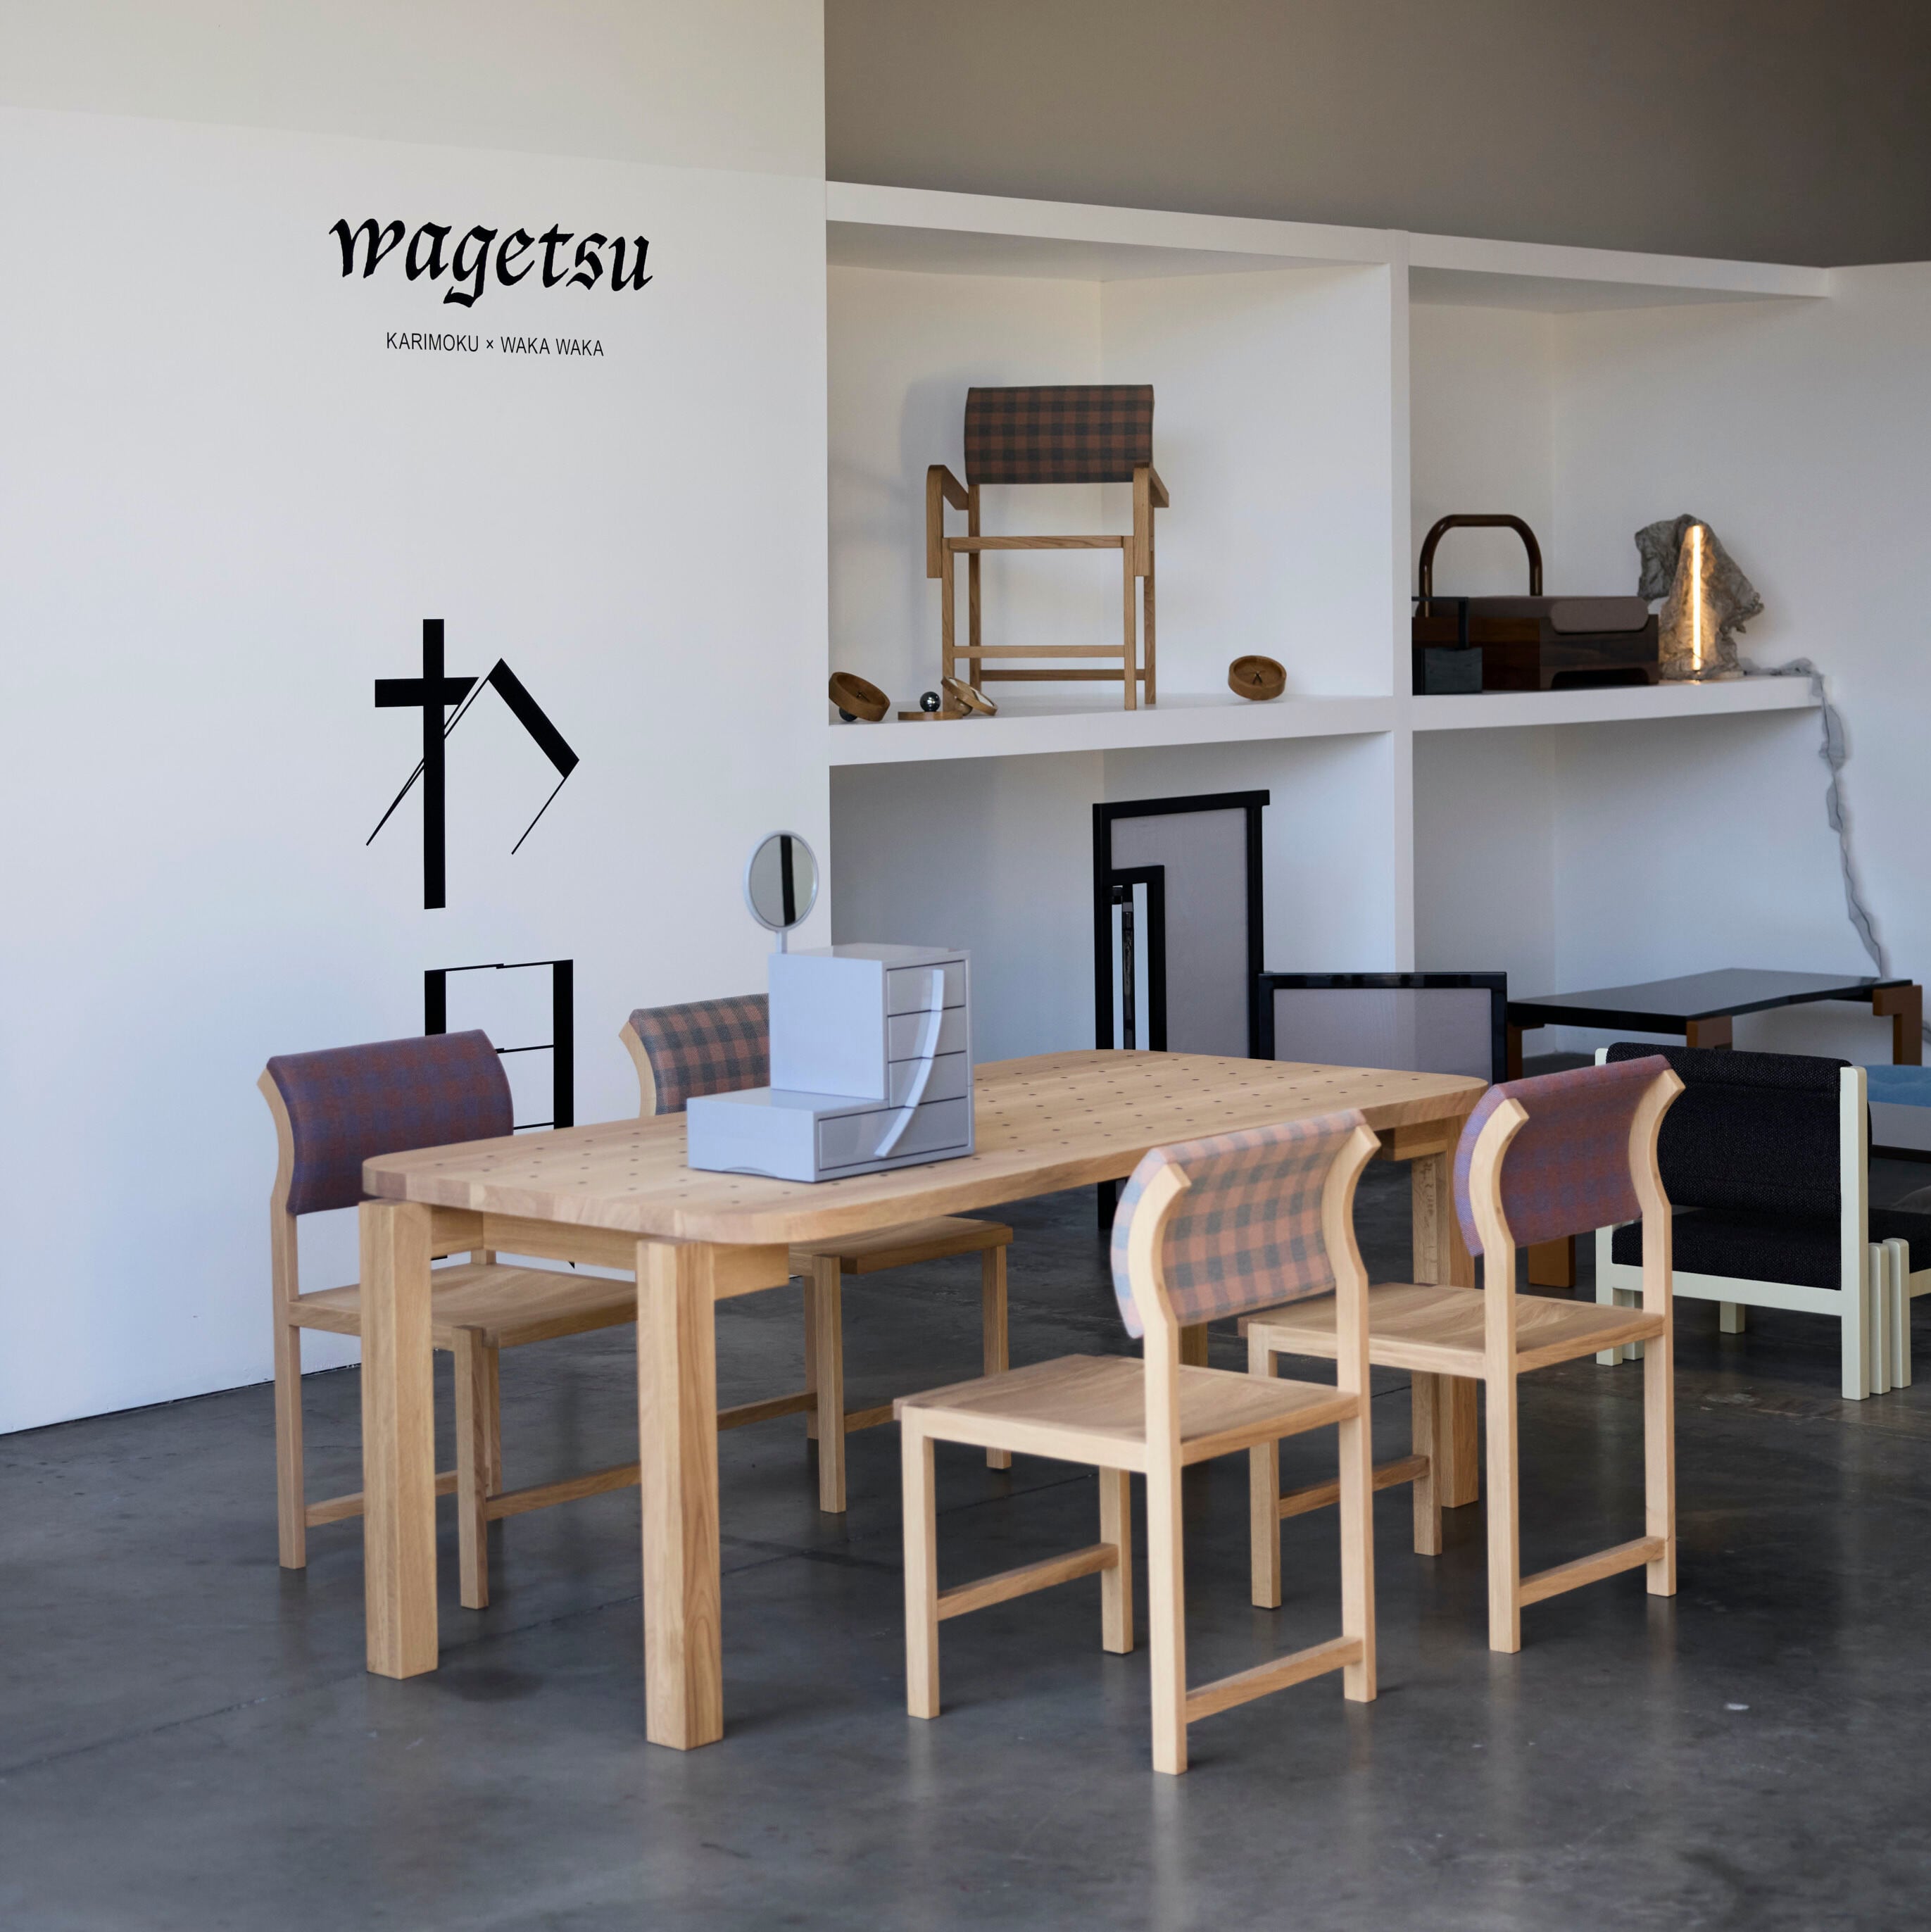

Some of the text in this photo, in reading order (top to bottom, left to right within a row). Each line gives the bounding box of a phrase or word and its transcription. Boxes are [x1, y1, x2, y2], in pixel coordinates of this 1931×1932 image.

[328, 218, 653, 308] wagetsu
[386, 332, 479, 352] KARIMOKU
[501, 336, 551, 356] WAKA
[555, 339, 604, 357] WAKA
